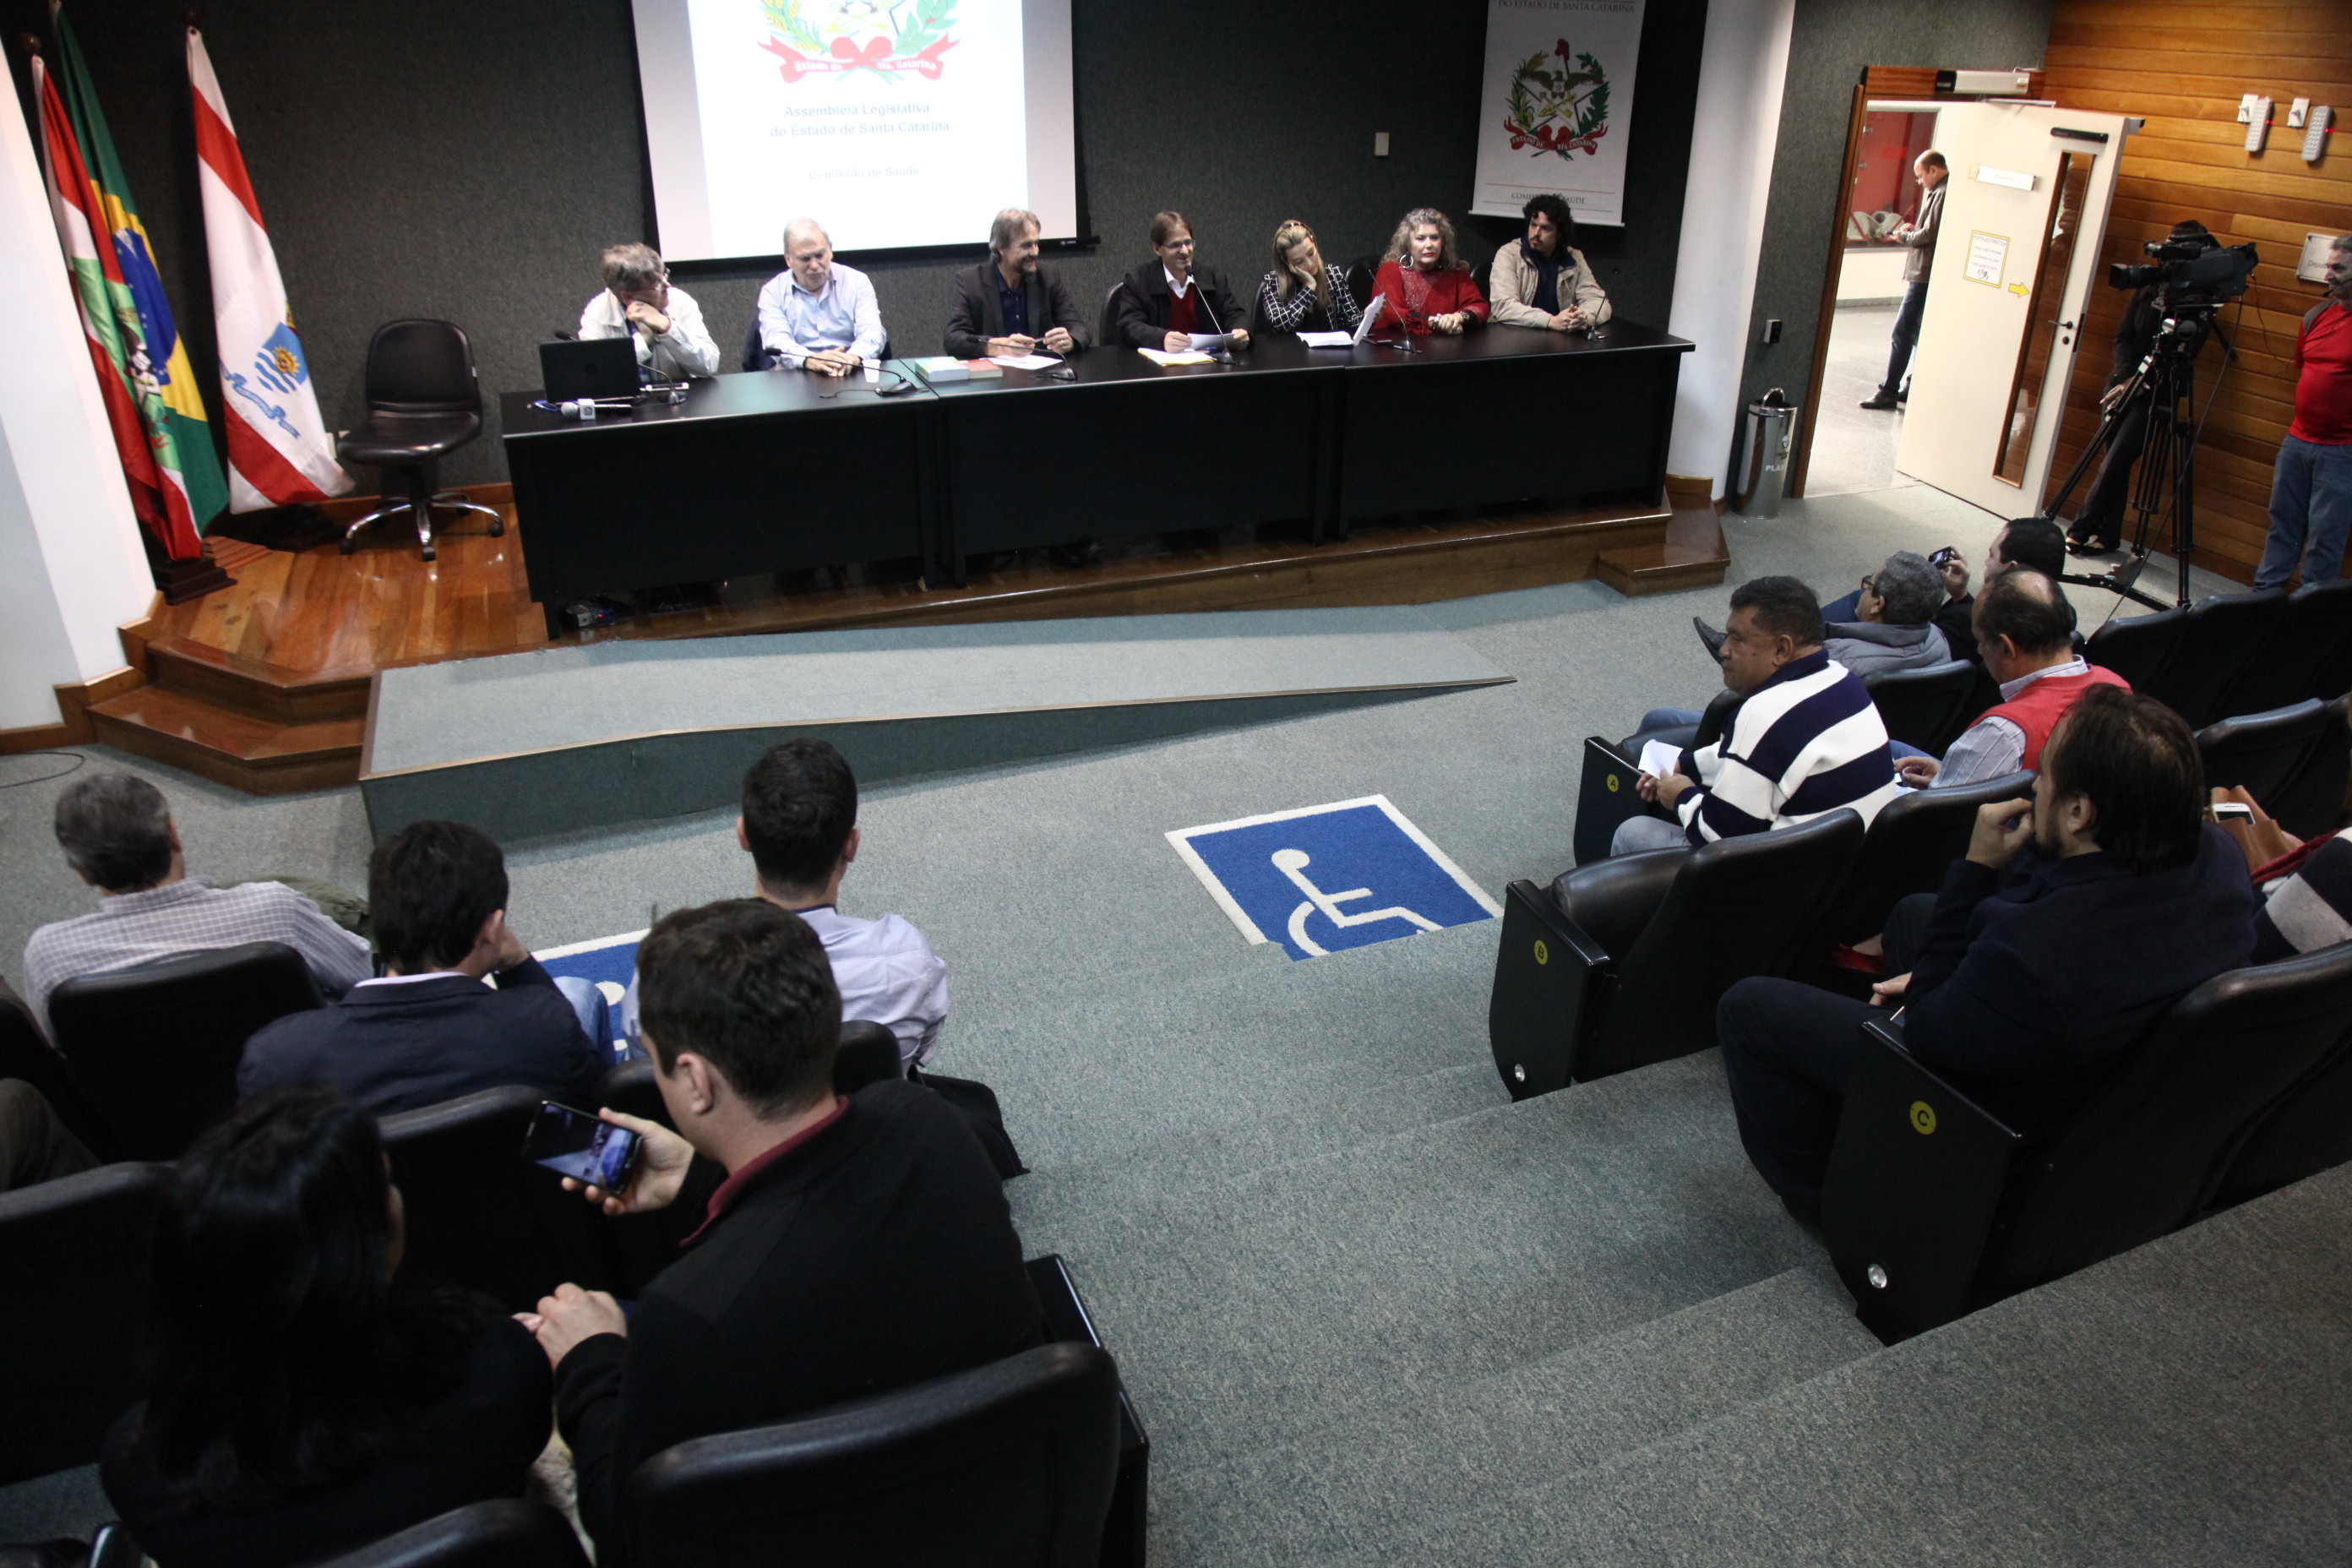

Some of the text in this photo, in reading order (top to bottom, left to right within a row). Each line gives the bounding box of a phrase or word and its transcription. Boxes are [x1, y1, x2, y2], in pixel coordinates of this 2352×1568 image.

[1515, 0, 1547, 9] ESTADO
[1562, 3, 1589, 11] SANTA
[1591, 3, 1635, 13] CATARINA
[784, 102, 930, 117] Assembleia Legislativa
[770, 120, 950, 137] do Estado de Santa Catarina
[1609, 779, 1616, 789] A
[1538, 945, 1544, 959] B
[1917, 1109, 1930, 1126] C
